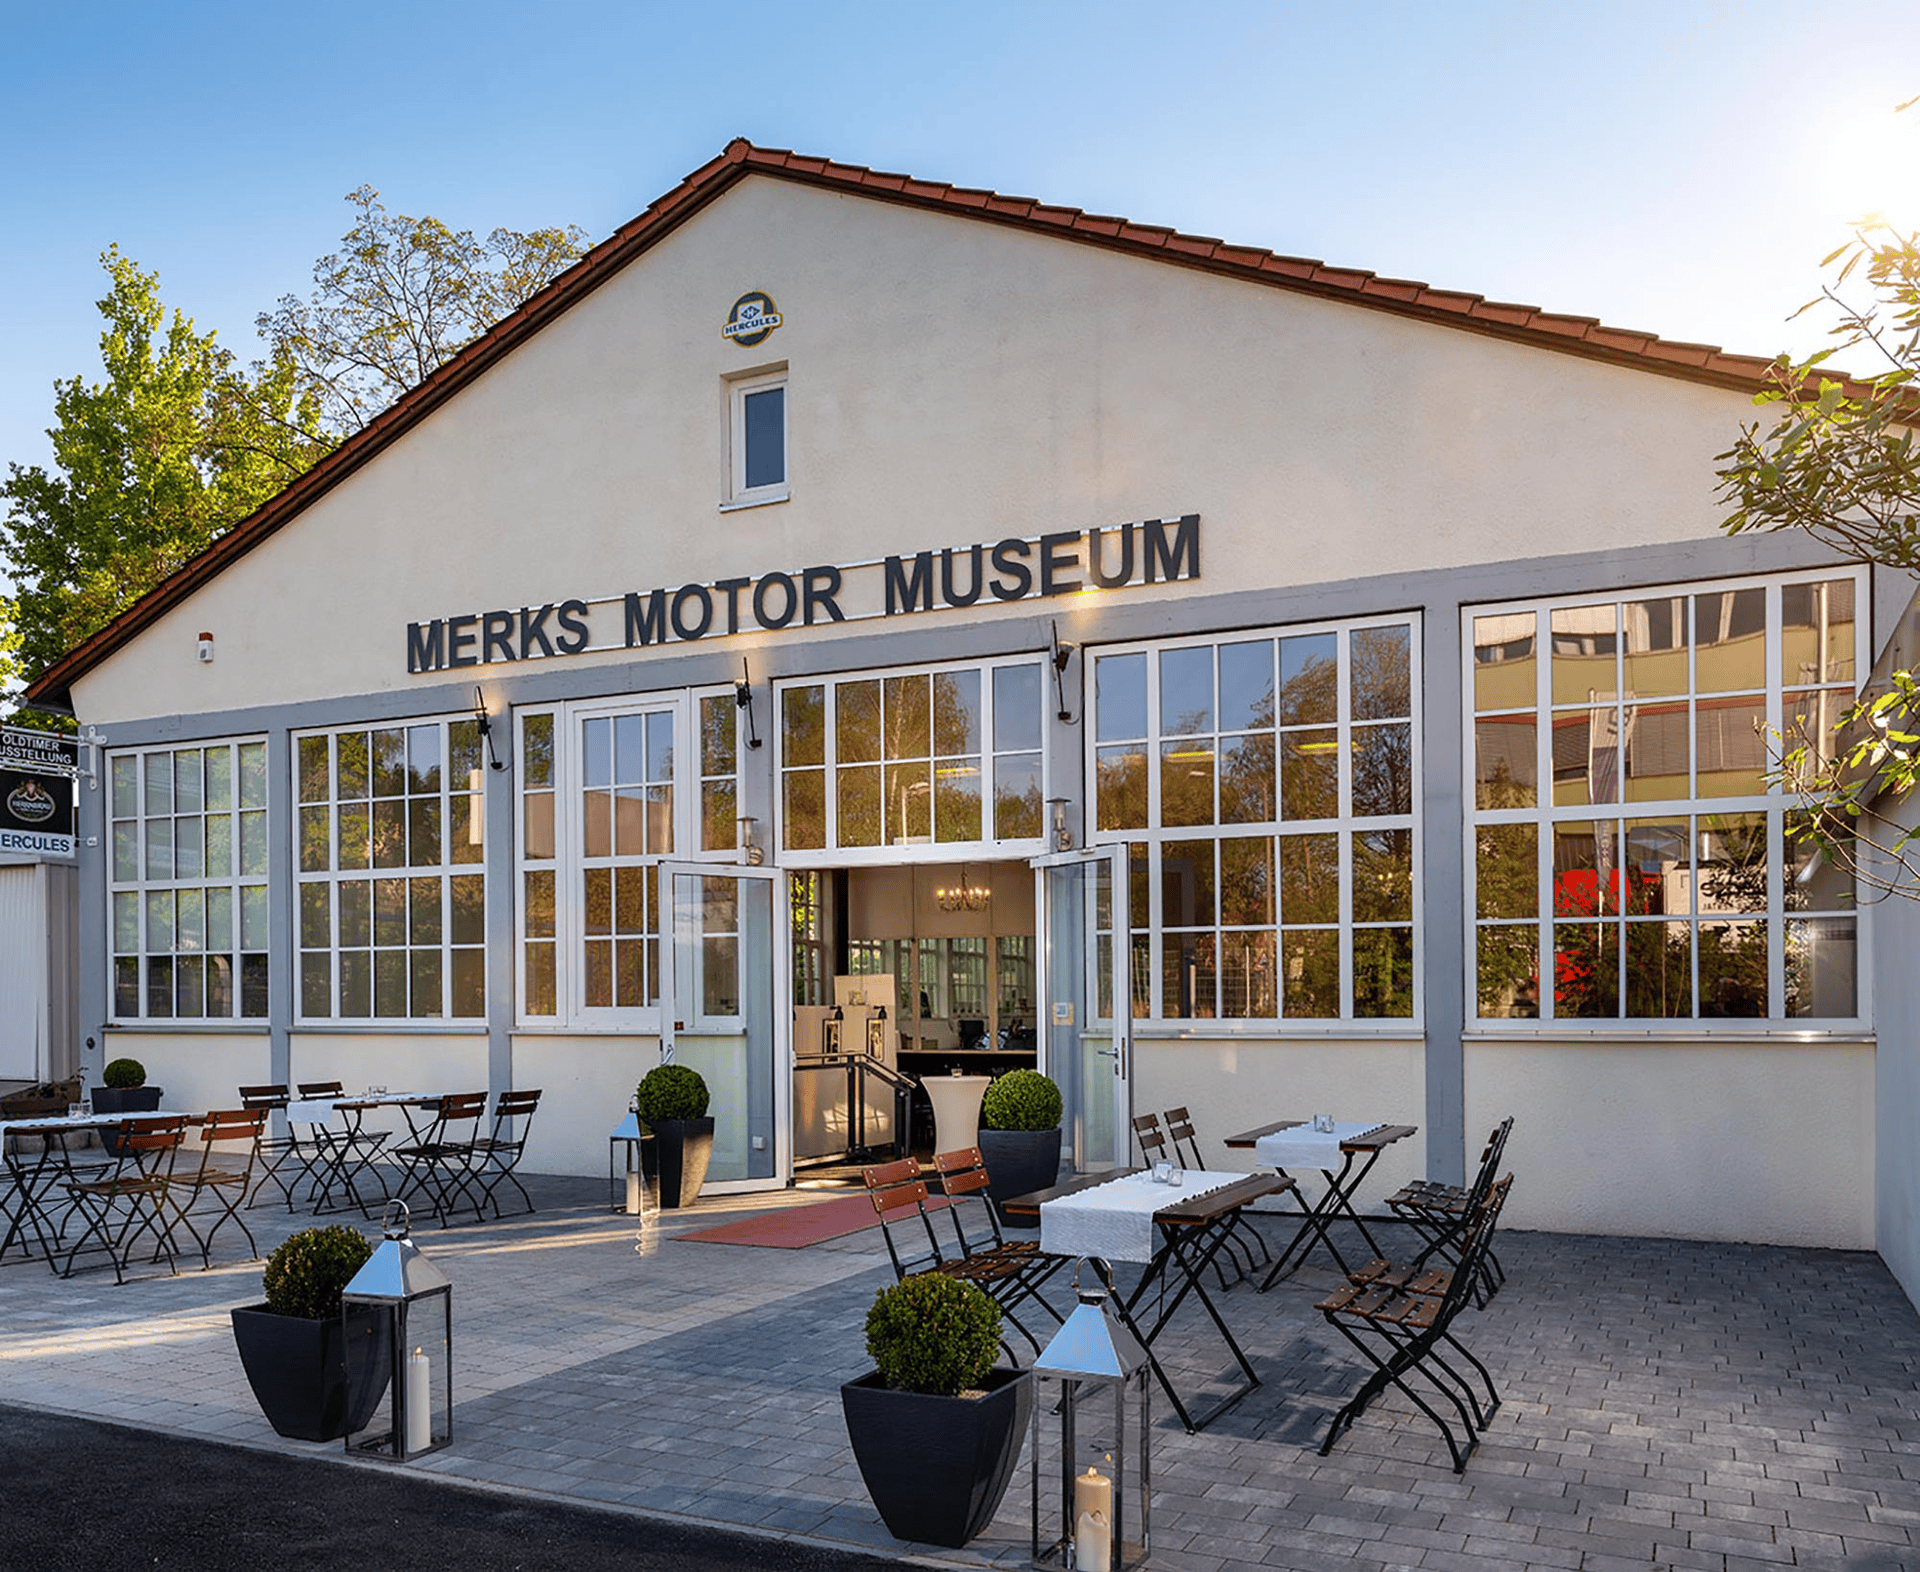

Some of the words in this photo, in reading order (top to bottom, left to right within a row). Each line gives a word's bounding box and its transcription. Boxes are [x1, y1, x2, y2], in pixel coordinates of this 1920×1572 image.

[725, 315, 779, 335] HERCULES
[407, 600, 588, 673] MERKS
[624, 565, 846, 648] MOTOR
[884, 513, 1200, 616] MUSEUM
[2, 733, 60, 752] OLDTIMER
[1, 833, 70, 852] ERCULES
